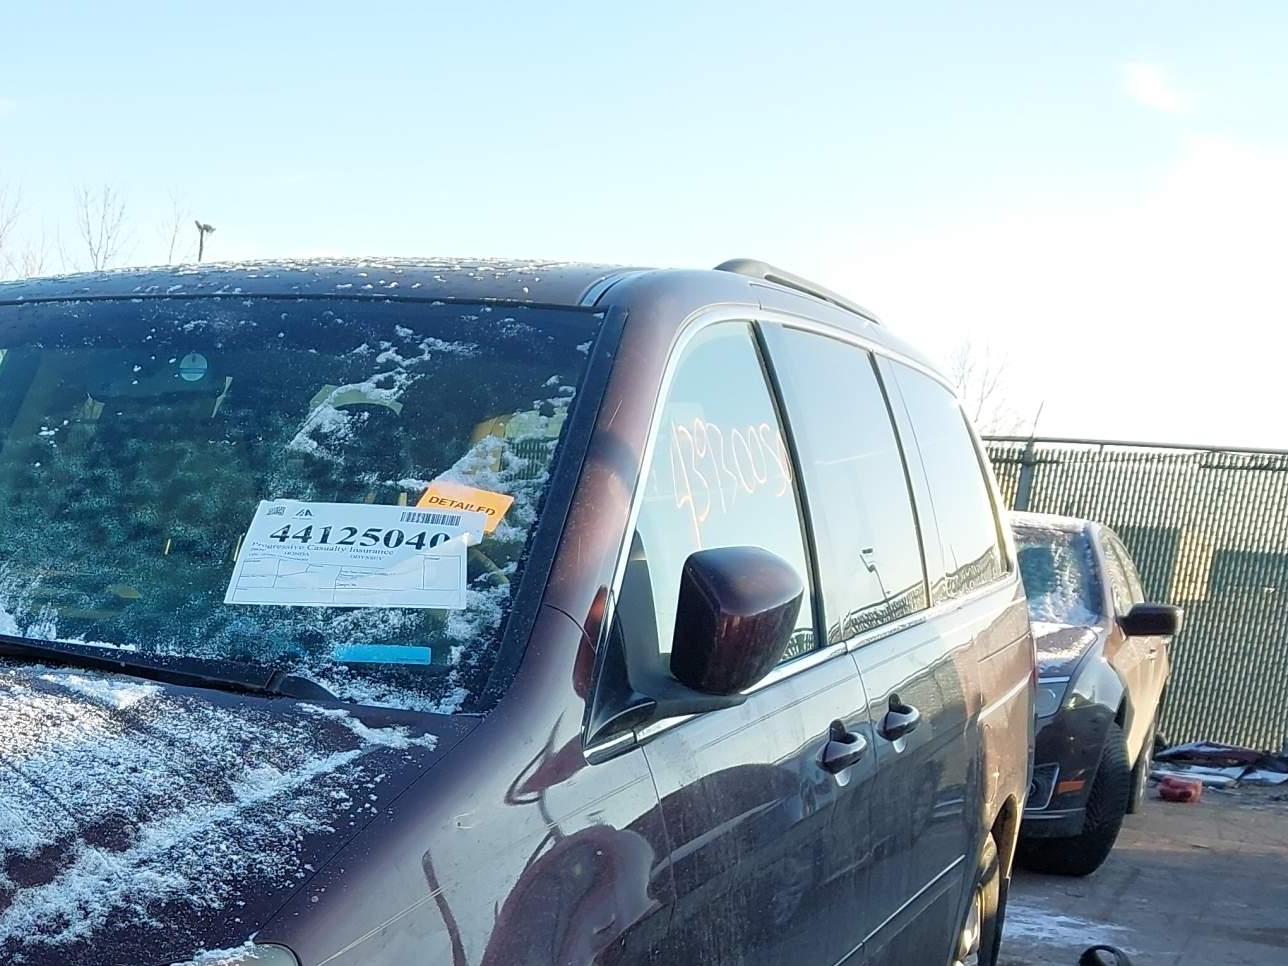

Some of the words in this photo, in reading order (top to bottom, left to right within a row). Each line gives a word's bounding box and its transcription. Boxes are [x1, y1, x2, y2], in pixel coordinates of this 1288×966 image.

[427, 495, 496, 517] DETAILED
[269, 523, 451, 550] 44125040
[251, 541, 305, 551] Progressive
[307, 544, 347, 553] Casualty
[349, 546, 394, 556] Insurance
